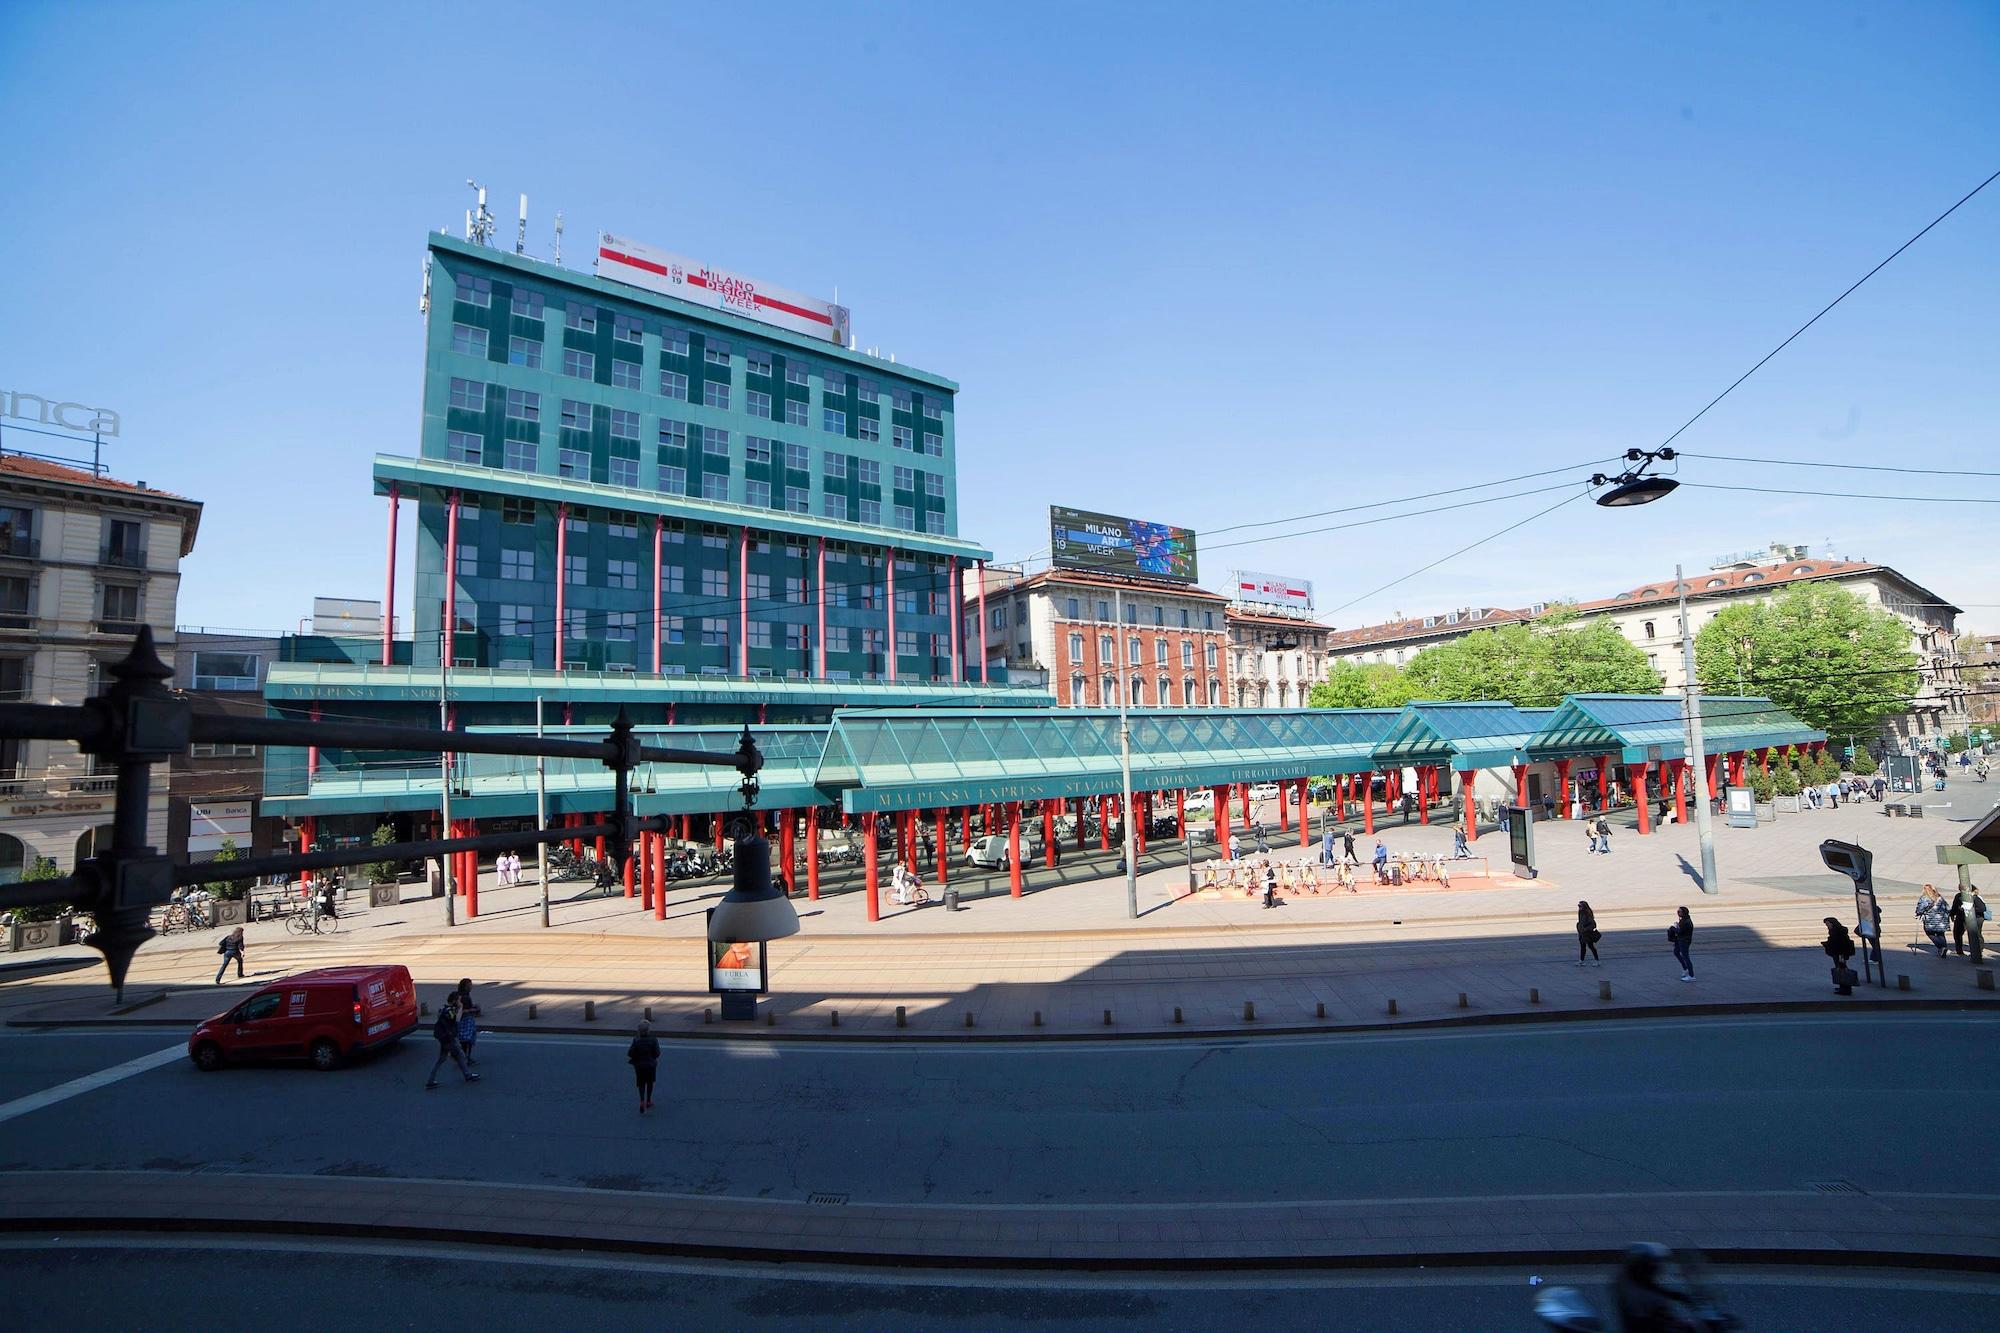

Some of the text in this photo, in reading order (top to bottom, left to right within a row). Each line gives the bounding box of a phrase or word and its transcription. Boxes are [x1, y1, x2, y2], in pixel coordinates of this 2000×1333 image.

[672, 276, 682, 284] 19
[700, 268, 754, 292] MILANO
[706, 281, 754, 301] DESIGN
[723, 294, 761, 312] WEEK
[0, 389, 120, 438] nca
[1085, 523, 1122, 538] MILANO
[1055, 539, 1067, 550] 19
[1101, 536, 1120, 546] ART
[1087, 544, 1116, 557] WEEK
[292, 686, 459, 698] MALPENSA EXPRESS
[1231, 765, 1307, 780] FERROVIENORD
[1066, 774, 1201, 793] STAZION CADORNA
[879, 784, 1044, 807] MALPENSA EXPRESS
[369, 982, 384, 994] BRT
[291, 993, 305, 1004] BRT
